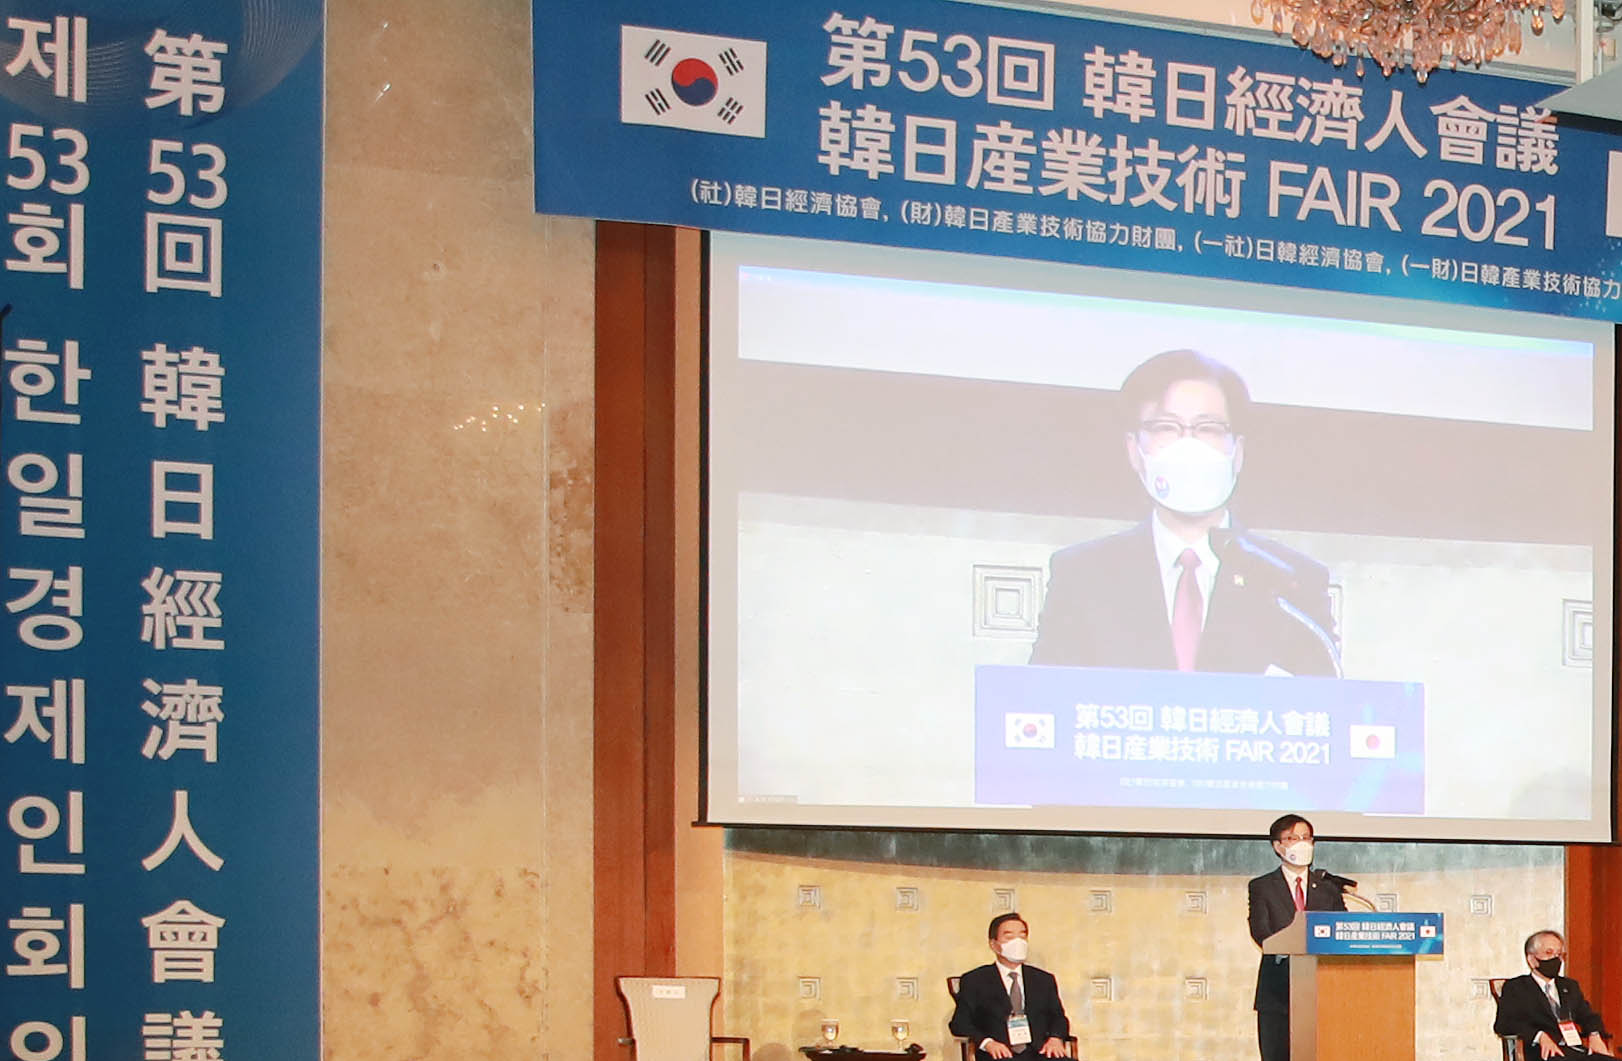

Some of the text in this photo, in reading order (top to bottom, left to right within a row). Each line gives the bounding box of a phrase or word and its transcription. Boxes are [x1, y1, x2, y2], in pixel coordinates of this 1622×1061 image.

[820, 12, 1559, 176] 第53回 韓日經濟人會議
[817, 101, 1556, 250] 韓日産業技術 FAIR 2021
[1226, 740, 1275, 764] FAIR
[1280, 741, 1330, 765] 2021
